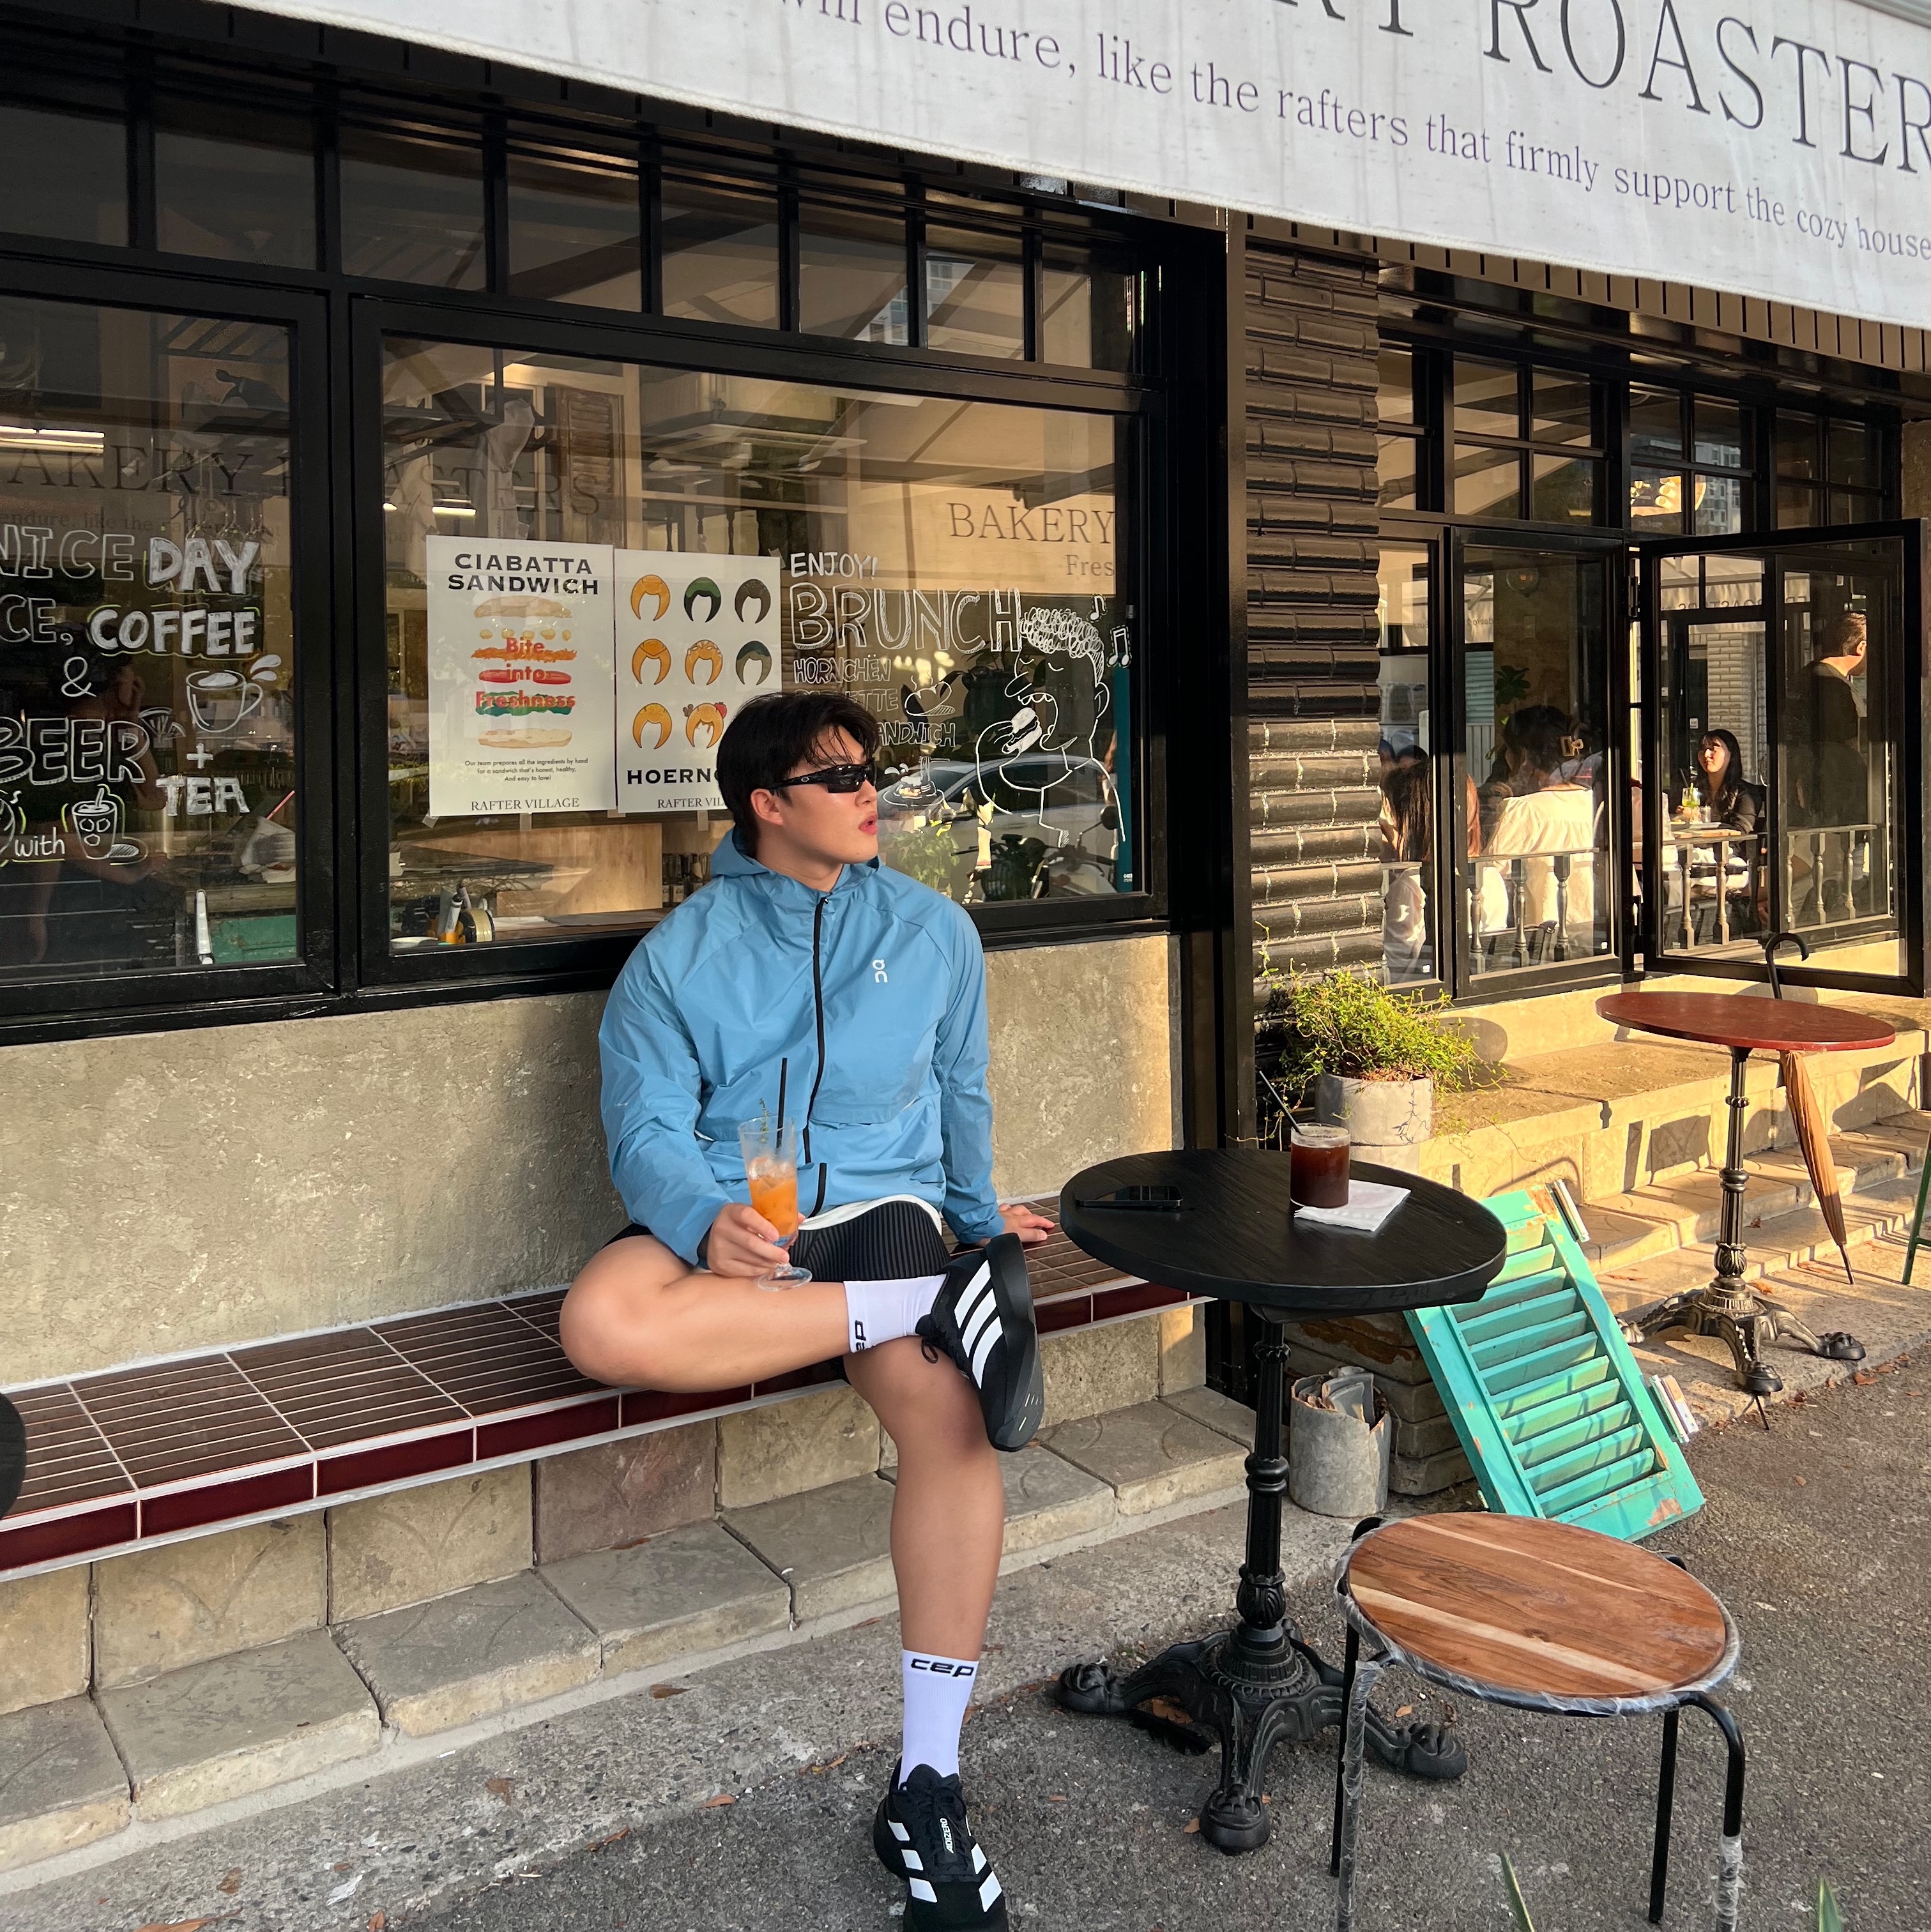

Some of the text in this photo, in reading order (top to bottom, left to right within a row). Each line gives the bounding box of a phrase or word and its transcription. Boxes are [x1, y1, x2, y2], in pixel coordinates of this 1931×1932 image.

[885, 1, 1076, 78] endure,
[1097, 33, 1172, 94] like
[1190, 63, 1259, 112] the
[1277, 89, 1408, 146] rafters
[1426, 114, 1490, 164] that
[1505, 131, 1599, 192] firmly
[1615, 169, 1737, 210] support
[1746, 187, 1785, 226] the
[1797, 209, 1848, 249] cozy
[1856, 217, 1931, 260] house
[947, 503, 1115, 544] BAKERY
[149, 537, 259, 594] DAY
[455, 554, 593, 574] CIABATTA
[791, 552, 878, 580] ENJOY!
[1065, 554, 1115, 576] Fres
[448, 574, 599, 595] SANDWICH
[790, 582, 1022, 654] BRUNCH
[90, 609, 256, 655] COFFEE
[506, 636, 545, 653] Bite
[61, 657, 96, 697] &
[506, 664, 546, 680] into
[476, 690, 576, 708] Freshness
[876, 720, 956, 748] ANDWICH
[567, 757, 574, 766] by
[627, 768, 719, 785] HOERN
[156, 775, 250, 816] TEA
[471, 798, 580, 811] RAFTER VILLAGE
[657, 798, 703, 809] RAFTER
[15, 826, 65, 856] with
[911, 1658, 975, 1678] cep
[940, 1818, 954, 1853] ADIZERO
